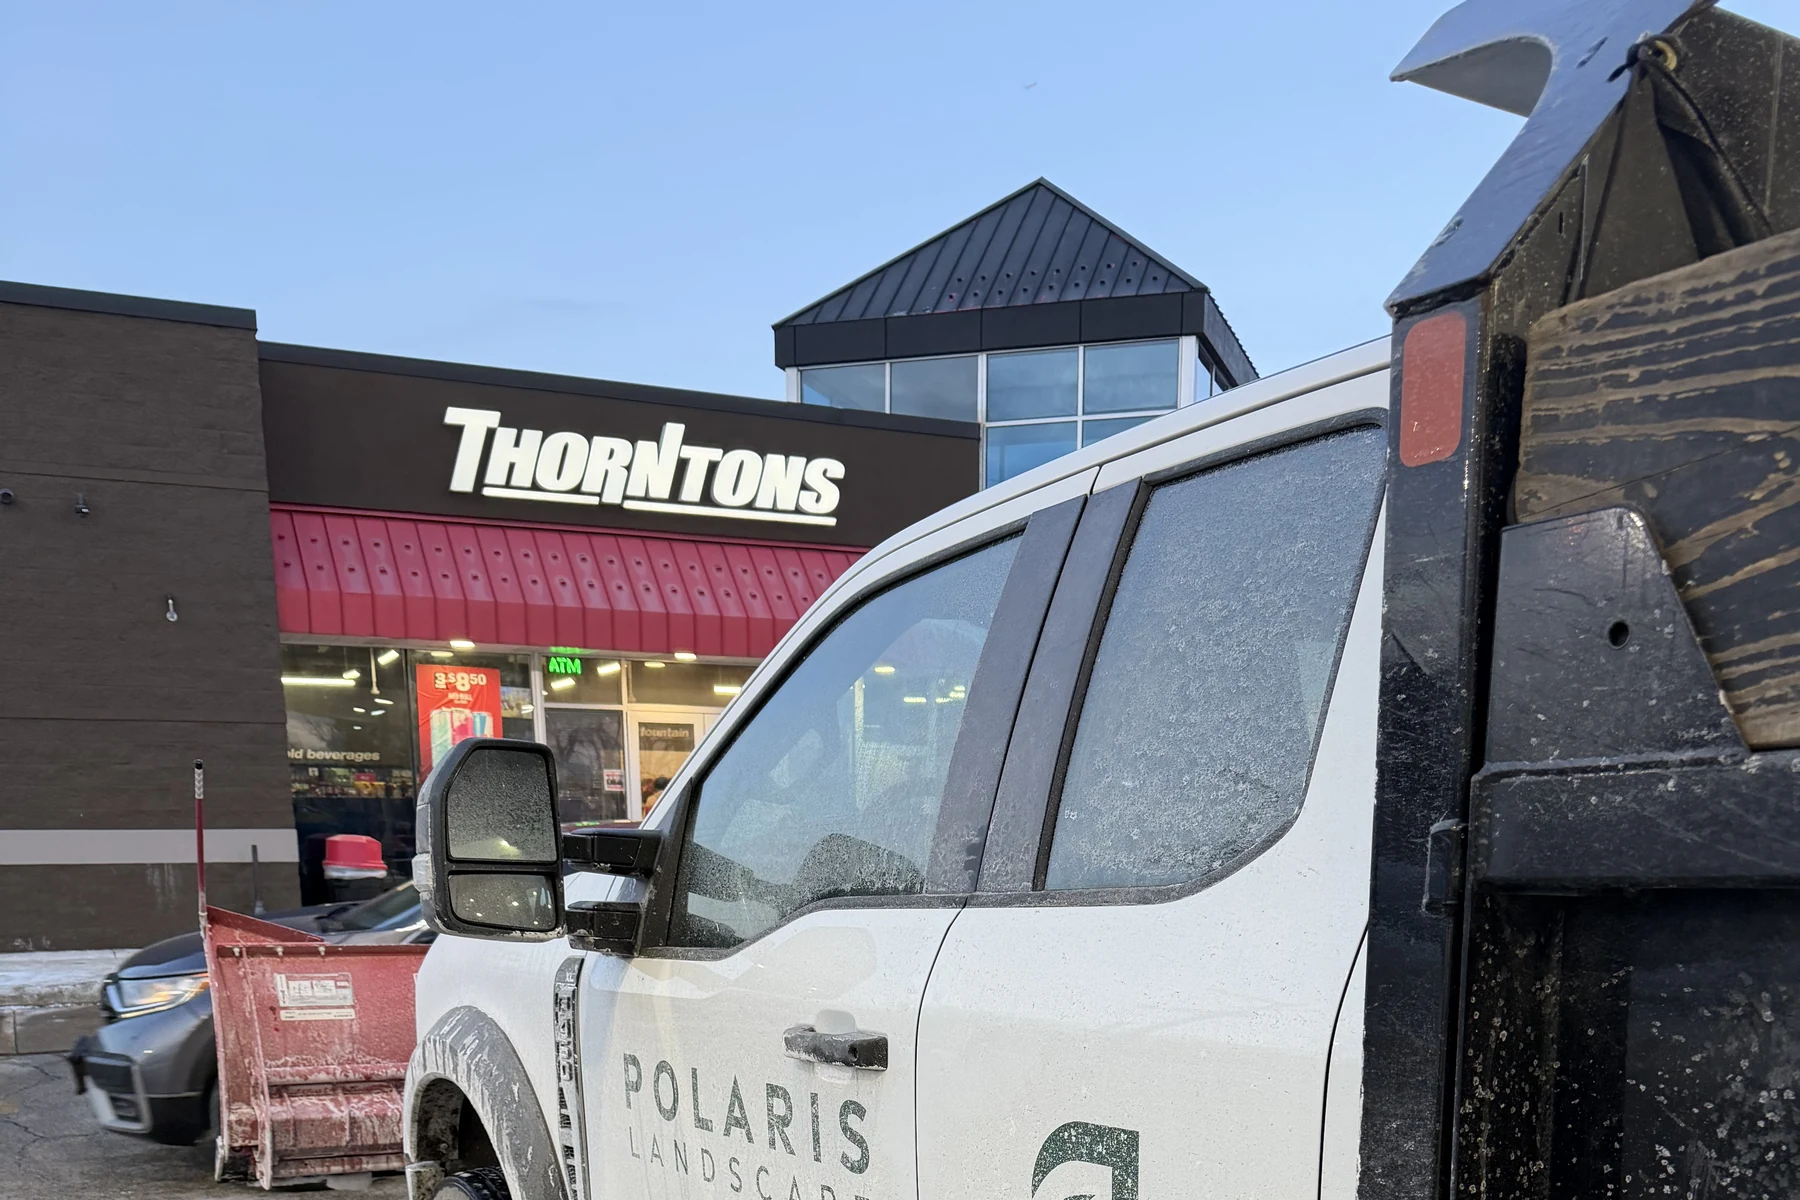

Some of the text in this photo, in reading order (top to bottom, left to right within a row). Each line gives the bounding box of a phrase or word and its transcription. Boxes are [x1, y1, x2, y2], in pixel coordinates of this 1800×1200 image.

[443, 406, 846, 516] THORNTONS
[548, 656, 582, 675] ATM
[640, 726, 690, 738] fountain
[306, 748, 381, 763] beverages
[623, 1053, 870, 1175] POLARIS
